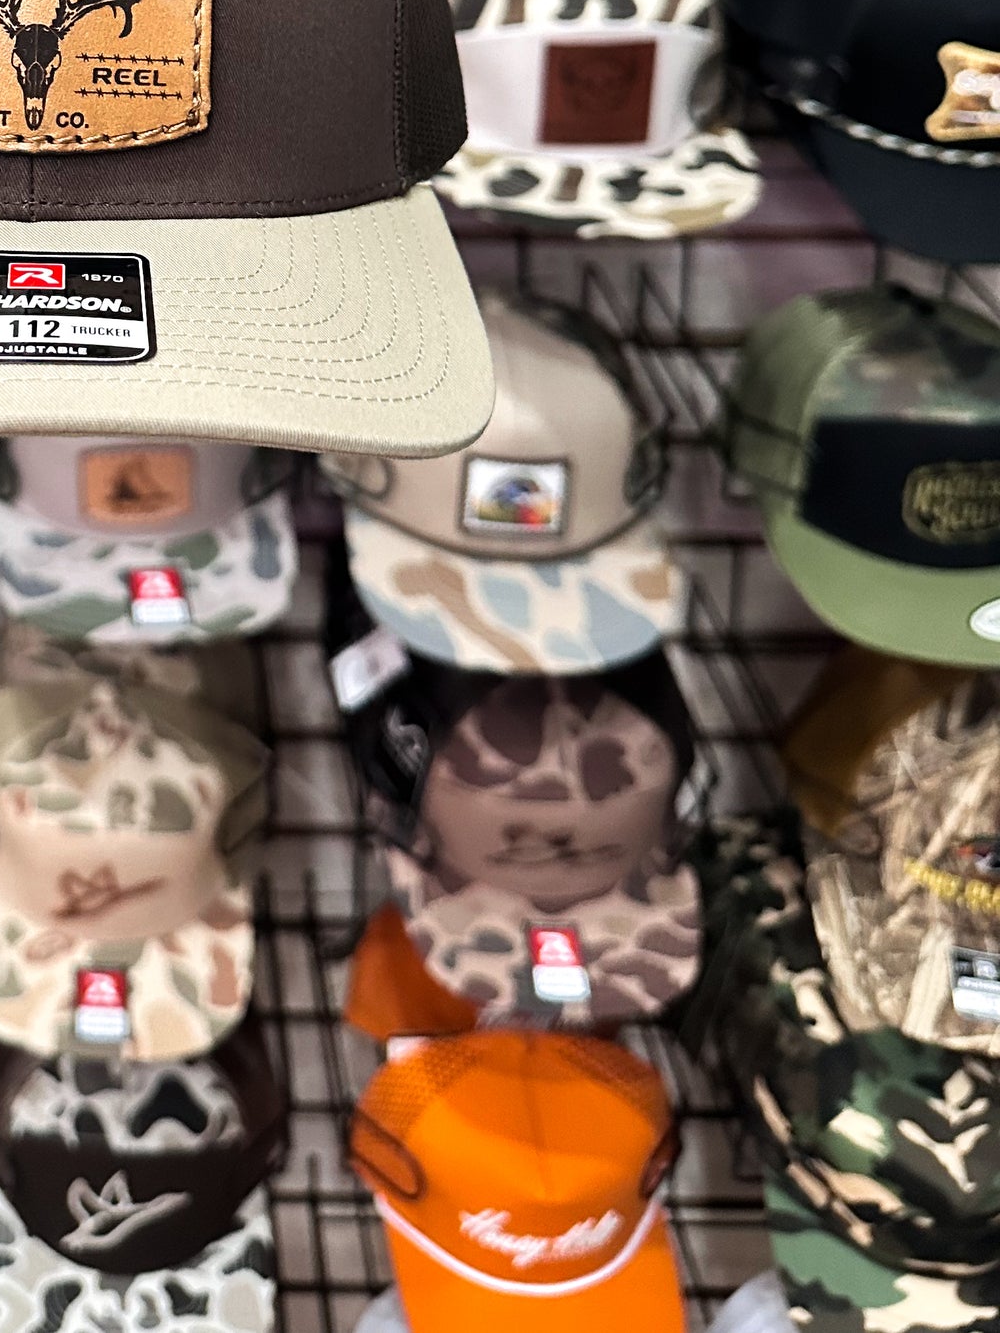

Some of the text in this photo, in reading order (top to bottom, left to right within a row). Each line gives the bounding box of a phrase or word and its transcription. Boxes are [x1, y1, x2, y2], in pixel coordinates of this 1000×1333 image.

[91, 68, 168, 87] REEL
[55, 111, 90, 129] CO.
[8, 319, 61, 339] 112
[71, 325, 132, 338] TRUCKER
